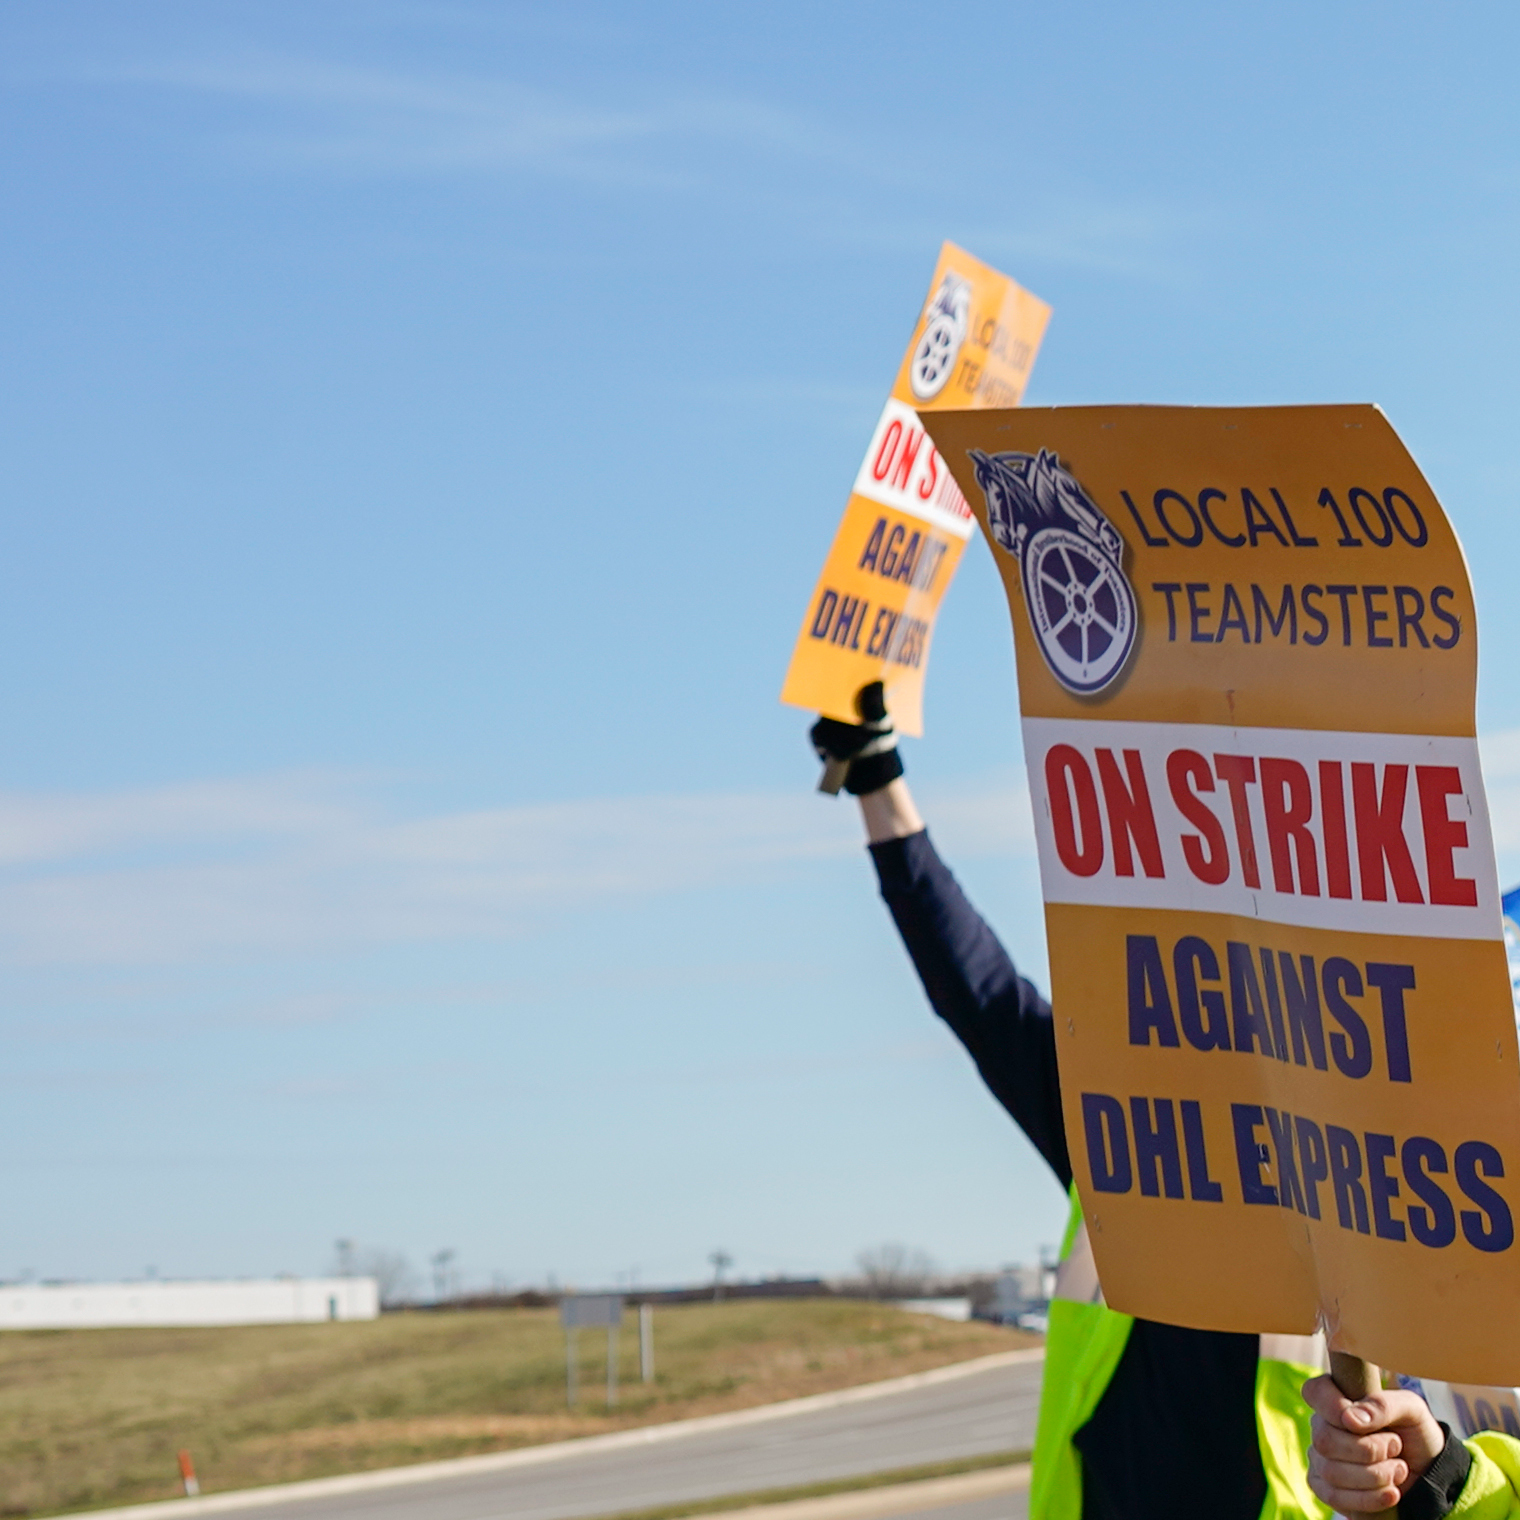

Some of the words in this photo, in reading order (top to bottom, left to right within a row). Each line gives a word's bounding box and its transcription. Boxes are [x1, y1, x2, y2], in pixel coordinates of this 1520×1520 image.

[874, 420, 925, 491] ON
[1120, 487, 1320, 548] LOCAL
[1317, 487, 1429, 548] 100
[811, 589, 868, 650] DHL
[1152, 582, 1462, 650] TEAMSTERS
[1044, 743, 1166, 879] ON
[1166, 749, 1478, 907] STRIKE
[1126, 934, 1416, 1083] AGAINST
[1081, 1092, 1223, 1203] DHL
[1231, 1103, 1514, 1253] EXPRESS
